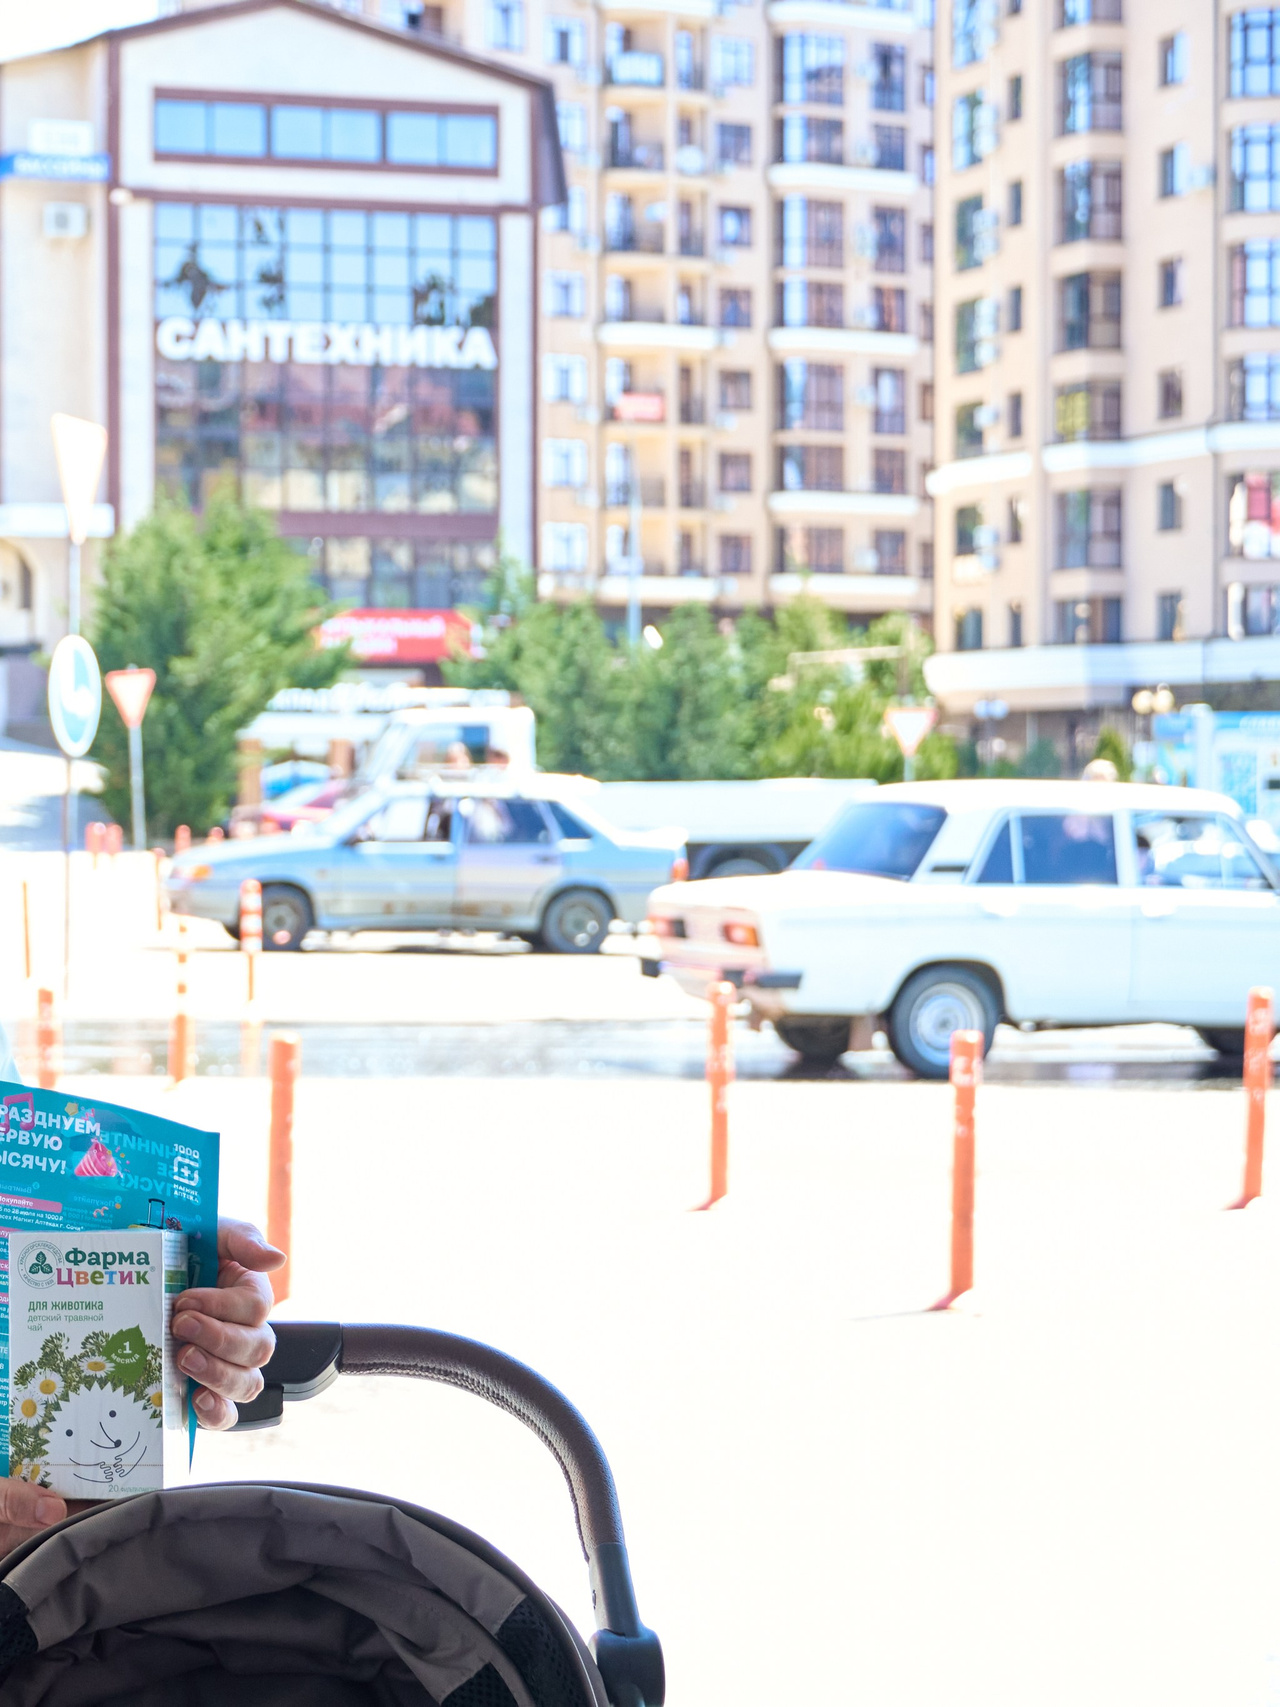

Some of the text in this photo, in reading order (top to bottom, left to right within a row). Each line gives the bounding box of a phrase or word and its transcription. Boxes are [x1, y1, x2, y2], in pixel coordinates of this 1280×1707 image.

[157, 316, 499, 370] САНТЕХНИКА
[173, 1143, 200, 1159] 1000
[64, 1247, 151, 1270] Фарма
[56, 1267, 150, 1288] Цветик
[27, 1300, 104, 1313] для животика
[27, 1313, 104, 1323] детский травяной
[27, 1323, 43, 1332] чай
[123, 1341, 133, 1354] 1
[110, 1352, 140, 1364] месяца
[108, 1484, 119, 1493] 20
